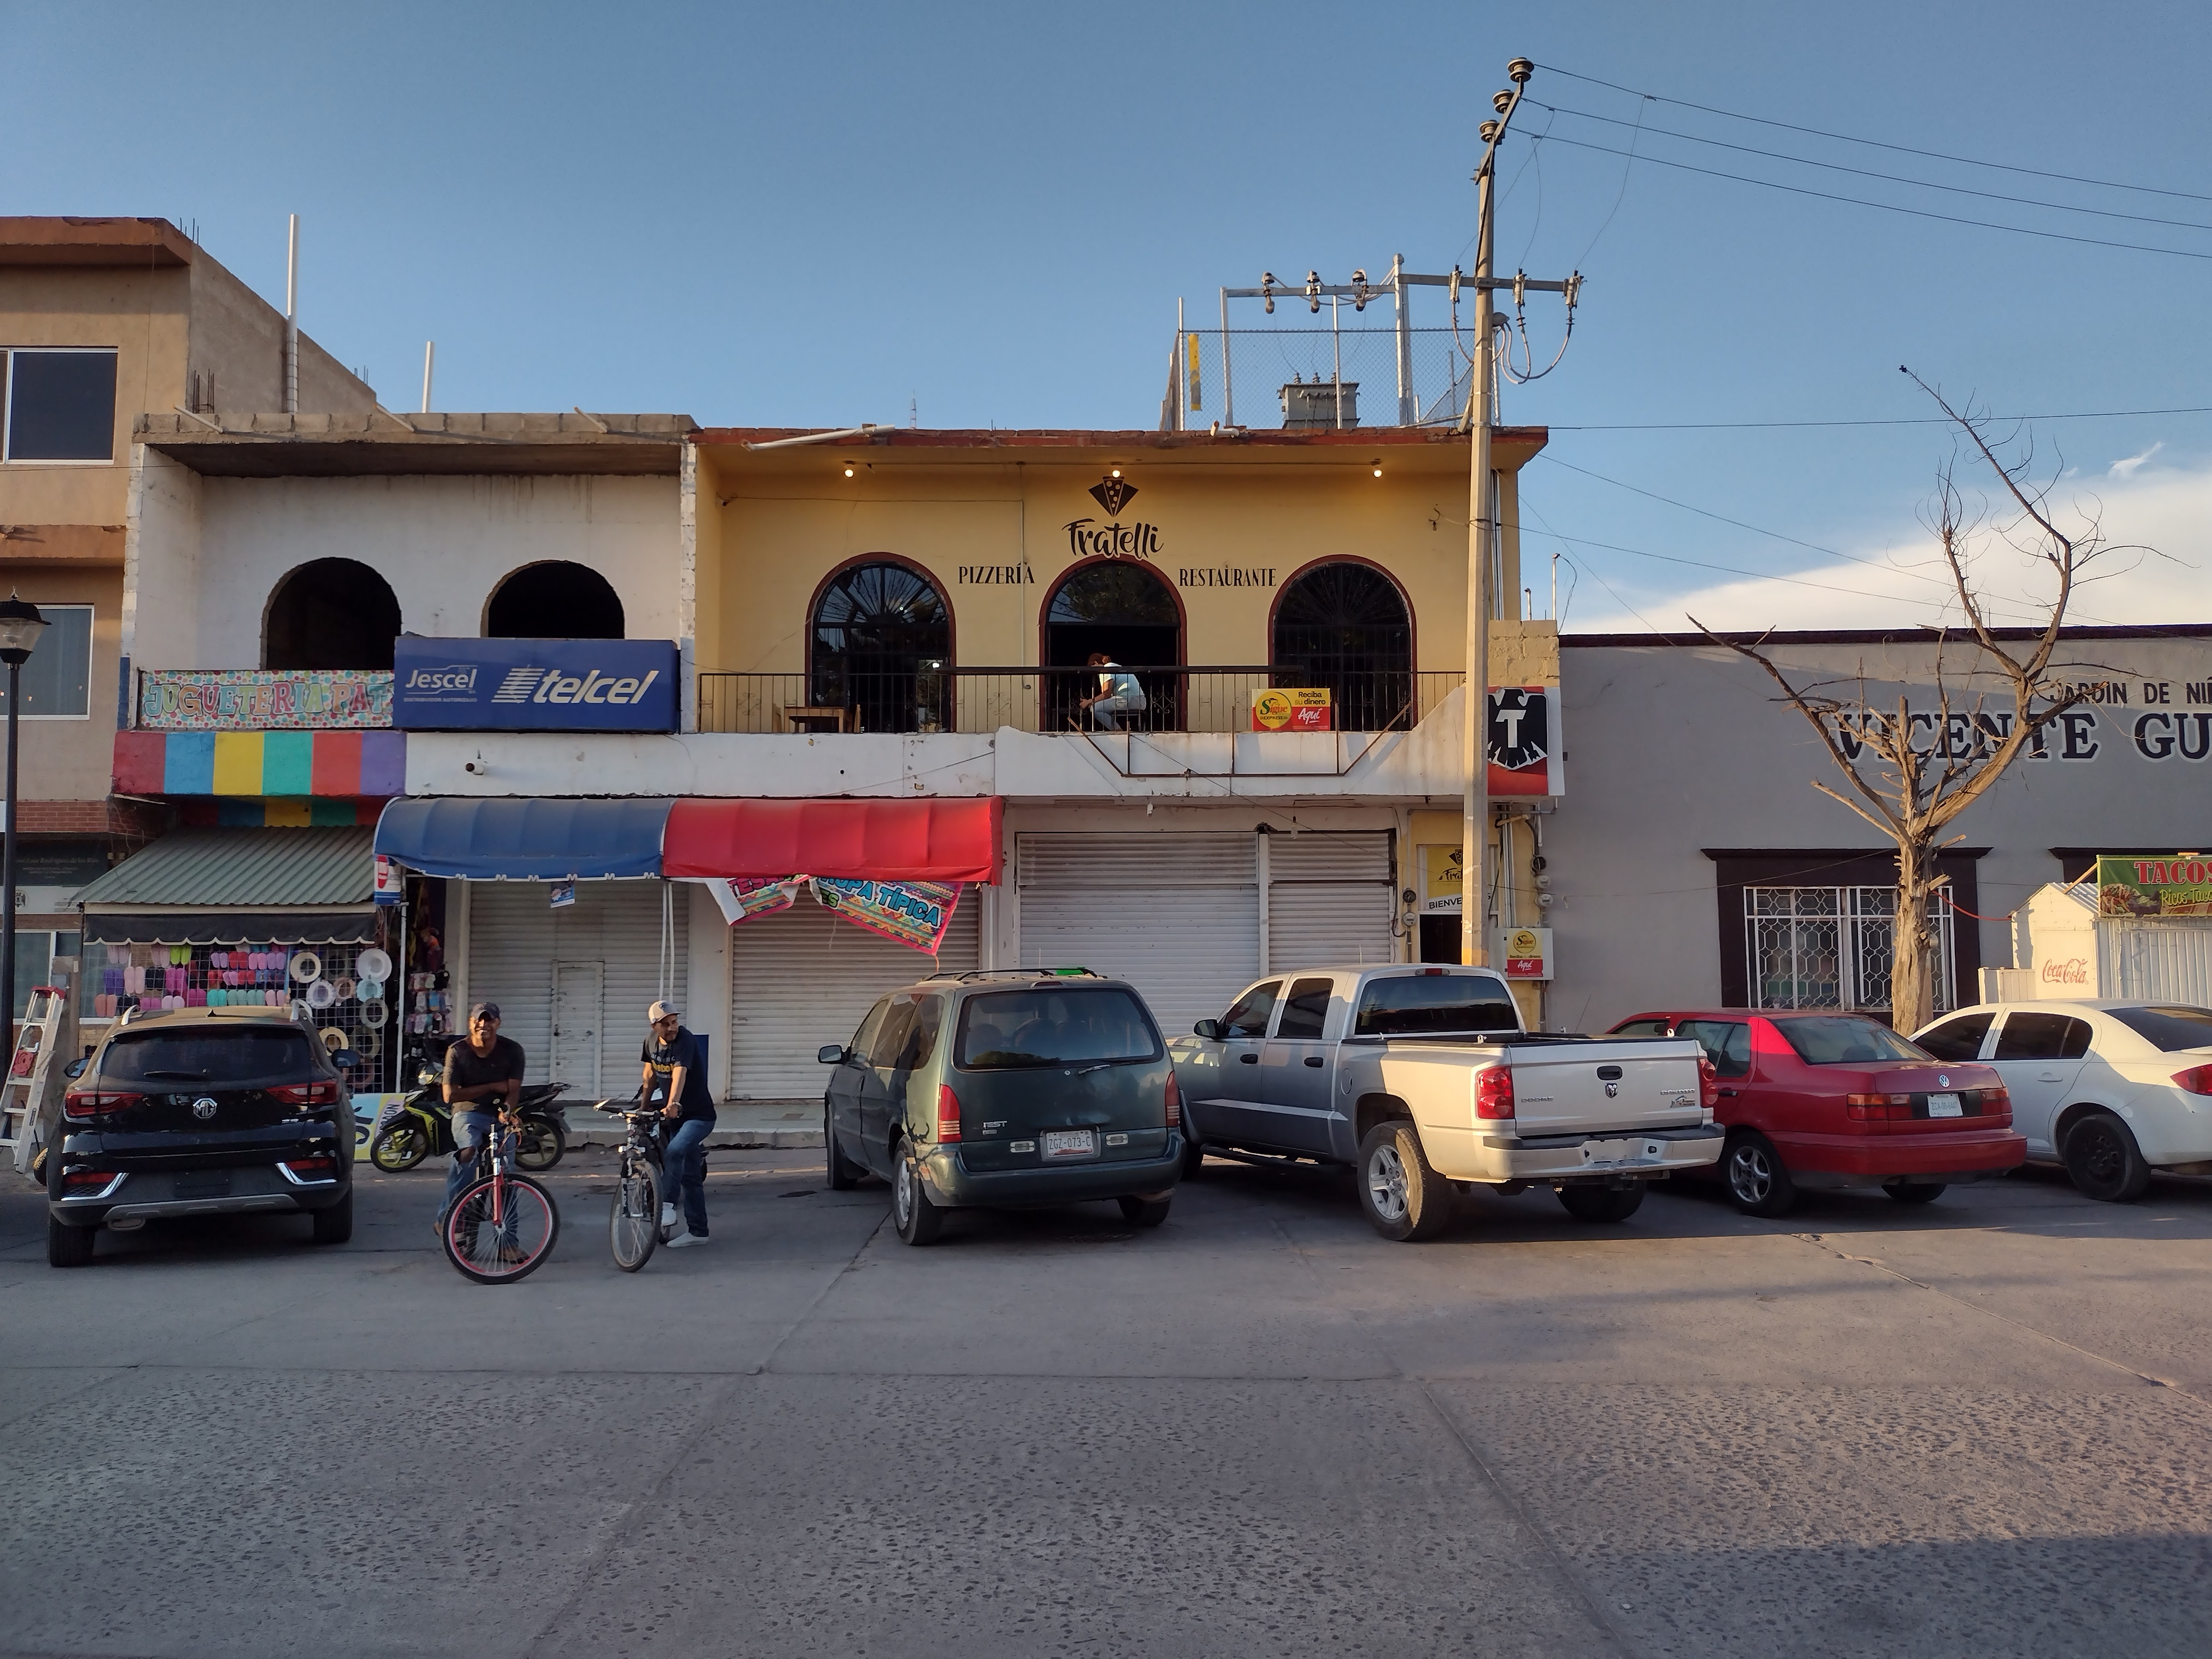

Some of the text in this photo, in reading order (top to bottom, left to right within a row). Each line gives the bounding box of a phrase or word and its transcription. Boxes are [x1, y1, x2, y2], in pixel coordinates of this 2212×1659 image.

[1062, 518, 1164, 559] Fratelli
[1179, 568, 1277, 587] RESTAURANTE
[406, 669, 477, 688] Jescel
[533, 670, 659, 704] telcel
[144, 682, 324, 717] JUGUETERIA
[2144, 682, 2170, 704] DE
[1260, 698, 1288, 715] Sigue
[1298, 708, 1323, 725] Aquí
[1839, 714, 2098, 759] VICENTE
[879, 886, 939, 927] TÍPICA
[1429, 898, 1462, 909] BIENVE
[2159, 888, 2188, 907] Ricos
[1518, 960, 1534, 971] Aquí
[2042, 959, 2088, 984] Coca-Cola
[195, 1100, 216, 1117] MG
[1048, 1136, 1091, 1150] ZGZ-073-C
